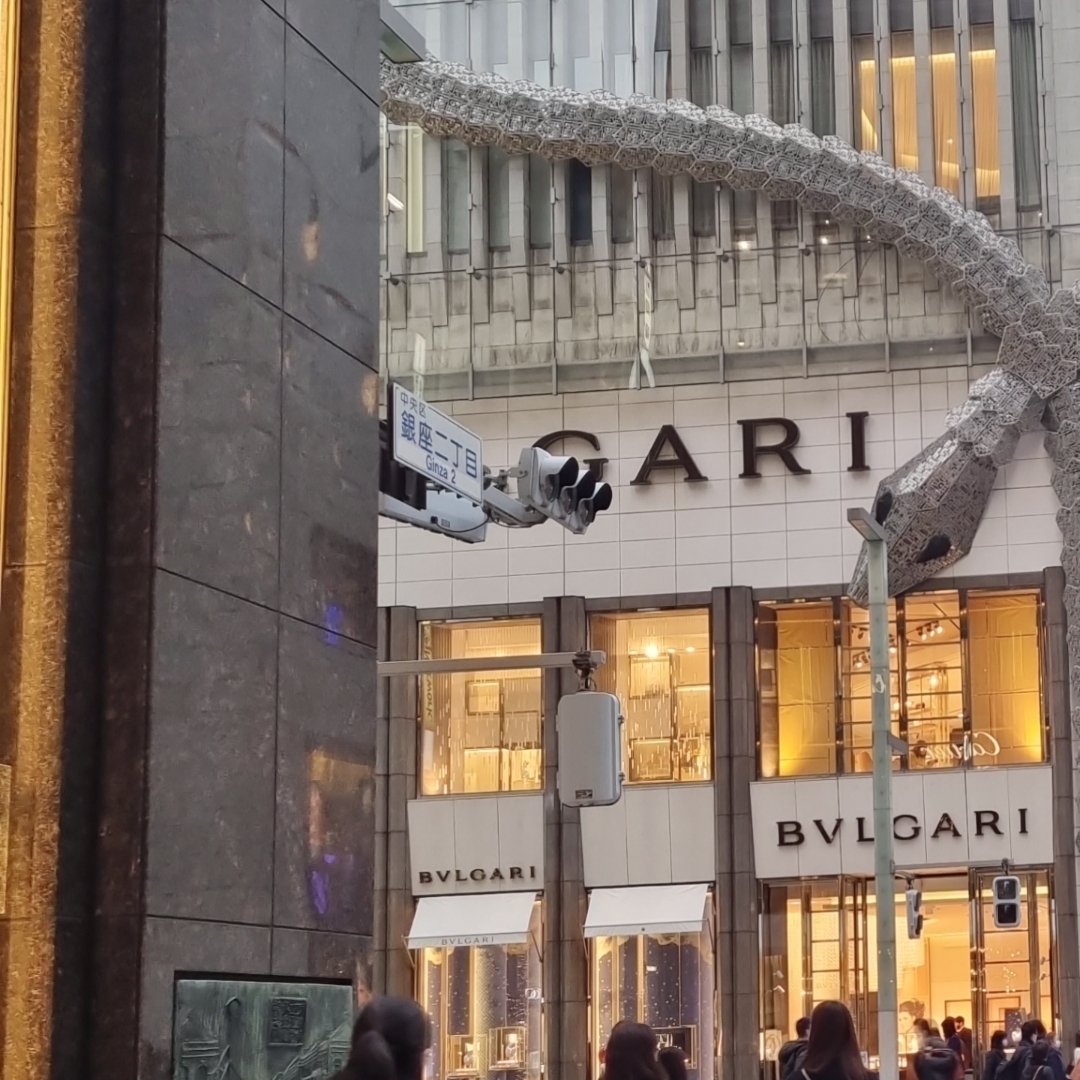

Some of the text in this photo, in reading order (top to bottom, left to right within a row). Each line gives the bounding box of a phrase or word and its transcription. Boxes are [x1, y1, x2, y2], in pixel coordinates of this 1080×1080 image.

[399, 390, 427, 419] 中央区
[401, 410, 478, 479] 銀座二丁目
[425, 453, 457, 485] Ginza 2
[776, 808, 1029, 847] BVLGARI
[418, 866, 536, 884] BVLGARI
[441, 936, 495, 946] BVLGARI
